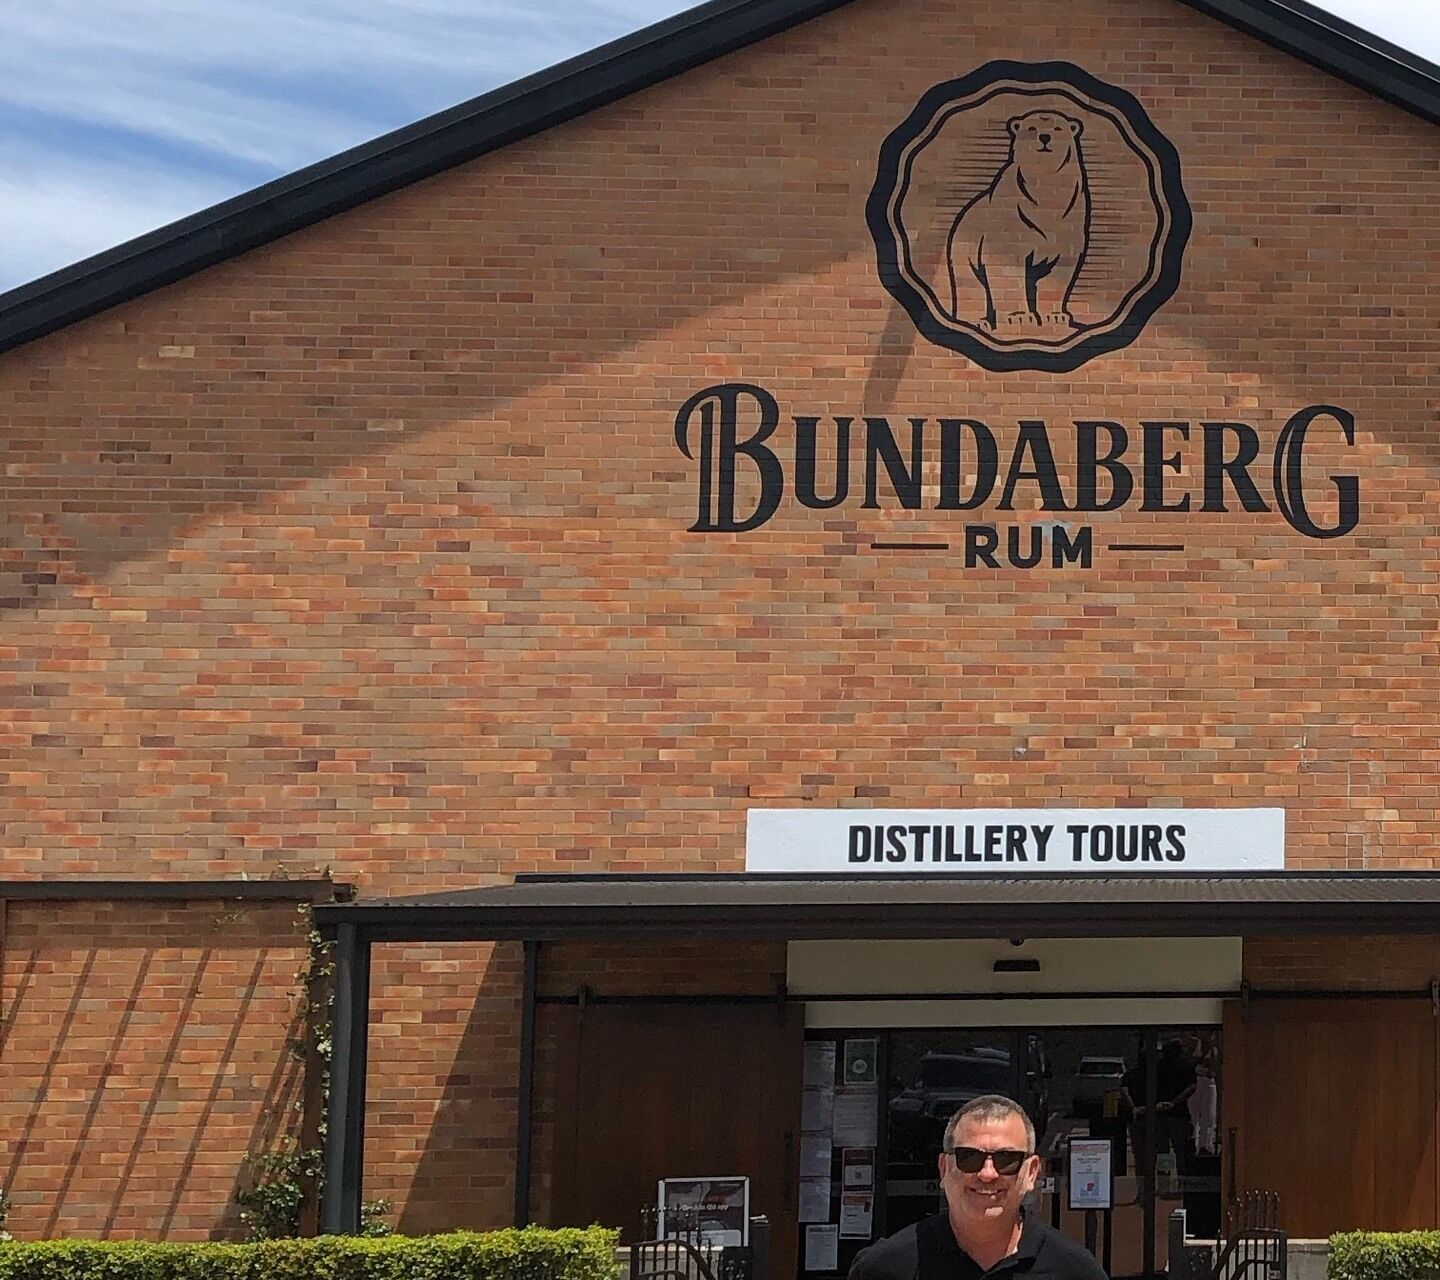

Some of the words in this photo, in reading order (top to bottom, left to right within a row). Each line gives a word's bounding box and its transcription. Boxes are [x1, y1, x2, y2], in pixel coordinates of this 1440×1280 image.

[674, 382, 1361, 540] BUNDABERG
[964, 525, 1094, 570] RUM
[848, 824, 1054, 863] DISTILLERY
[1067, 823, 1187, 863] TOURS
